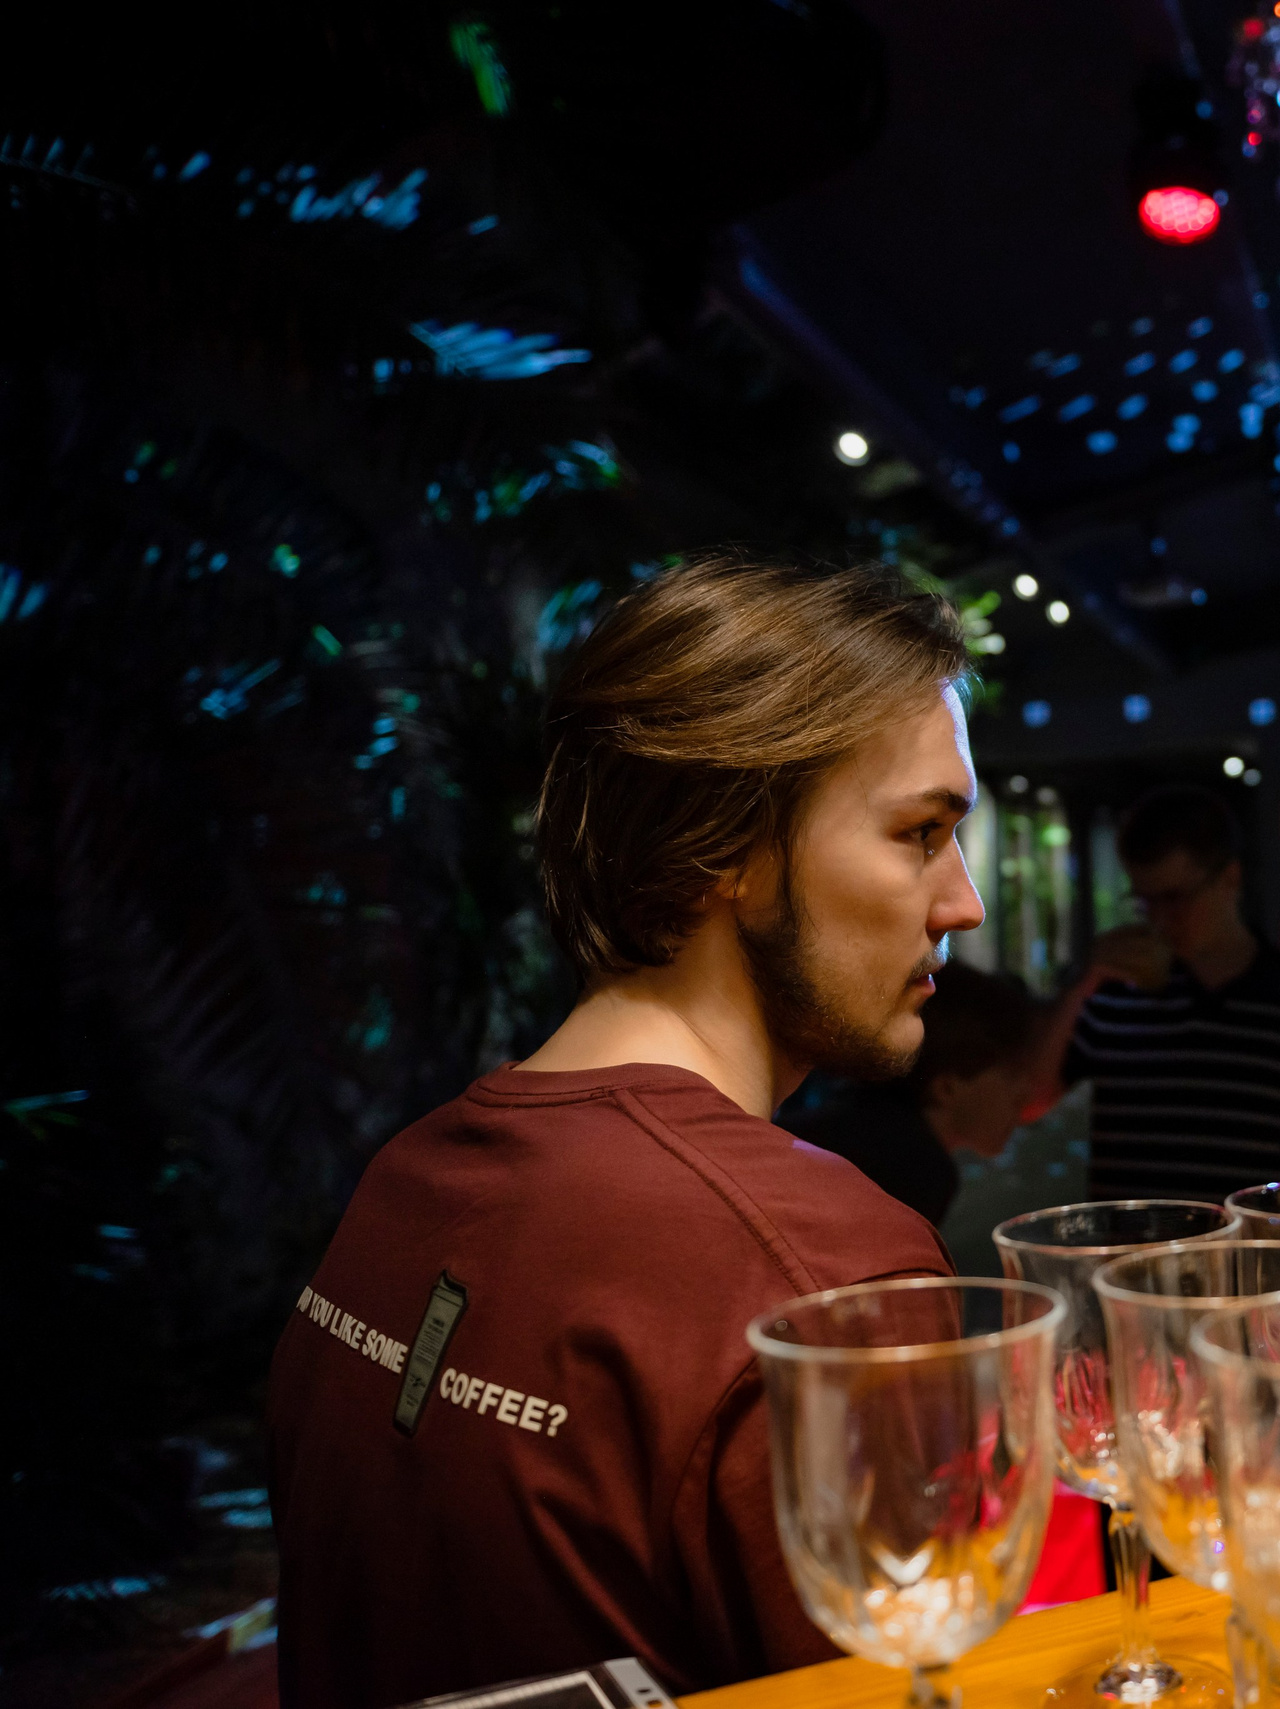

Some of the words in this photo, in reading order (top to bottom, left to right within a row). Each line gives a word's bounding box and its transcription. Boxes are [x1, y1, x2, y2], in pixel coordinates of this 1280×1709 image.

[309, 1293, 335, 1327] YOU
[330, 1308, 367, 1350] LIKE
[362, 1329, 409, 1374] SOME
[440, 1368, 568, 1437] COFFEE?
